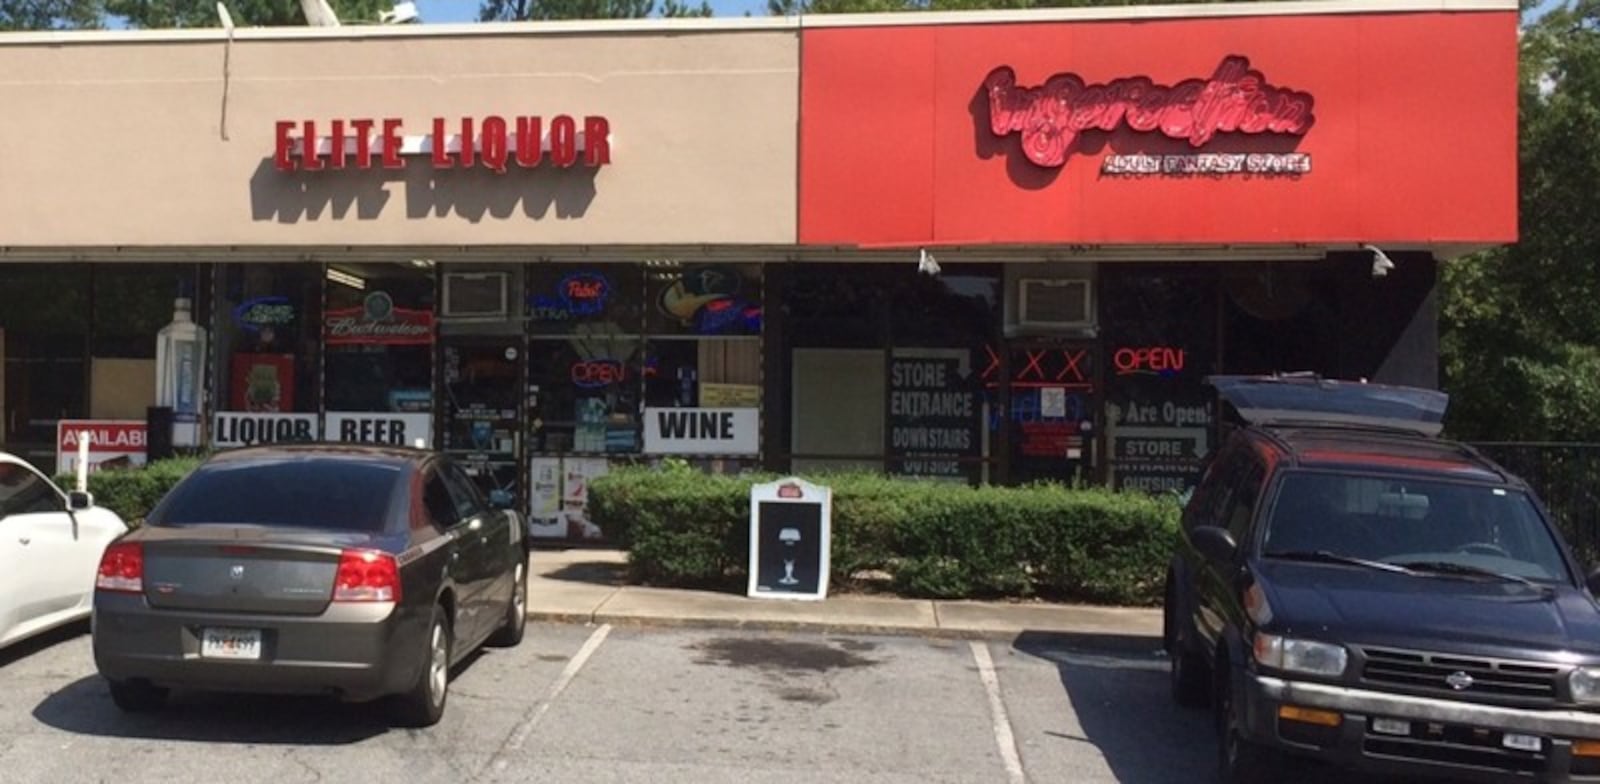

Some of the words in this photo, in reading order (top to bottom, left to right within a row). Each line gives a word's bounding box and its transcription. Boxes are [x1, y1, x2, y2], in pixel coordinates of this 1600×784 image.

[275, 118, 405, 171] ELITE
[432, 114, 612, 173] LIQUOR
[1164, 154, 1246, 173] FANTASY
[570, 361, 625, 383] OPEN
[1113, 347, 1185, 371] OPEN
[891, 361, 946, 388] STORE
[891, 391, 973, 418] ENTRANCE
[1126, 401, 1158, 423] Are
[1162, 400, 1213, 427] Open!
[216, 416, 313, 446] LIQUOR
[341, 418, 406, 446] BEER
[658, 411, 734, 439] WINE
[1125, 439, 1183, 456] STORE
